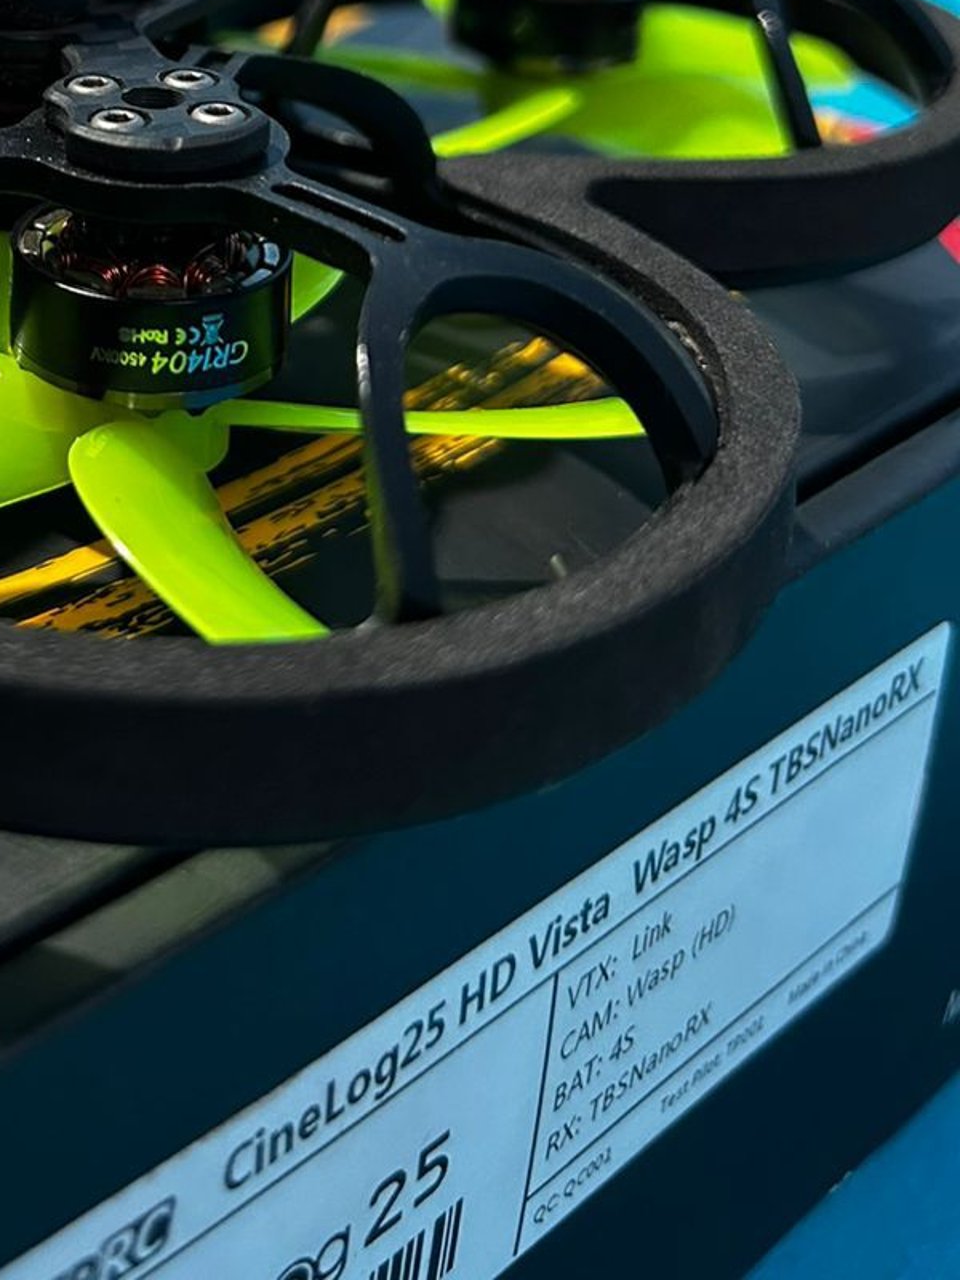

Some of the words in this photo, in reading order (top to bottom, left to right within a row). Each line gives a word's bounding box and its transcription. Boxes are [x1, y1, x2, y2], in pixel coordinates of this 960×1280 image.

[151, 340, 249, 375] GR1404
[223, 1000, 447, 1192] CineLog25
[458, 952, 517, 1025] HD
[528, 892, 611, 970] Vista
[632, 815, 717, 896] Wasp
[723, 774, 760, 825] 4S
[769, 656, 925, 796] TBSNanoRX
[559, 999, 621, 1061] CAM:
[626, 948, 686, 1008] Wasp
[691, 903, 736, 959] (HD)
[567, 954, 618, 1010] VTX:
[631, 910, 673, 961] Link
[544, 1114, 582, 1161] RX:
[590, 1000, 714, 1121] TBSNanoRX
[552, 1053, 603, 1113] BAT:
[609, 1024, 636, 1062] 4S
[363, 1129, 452, 1249] 25
